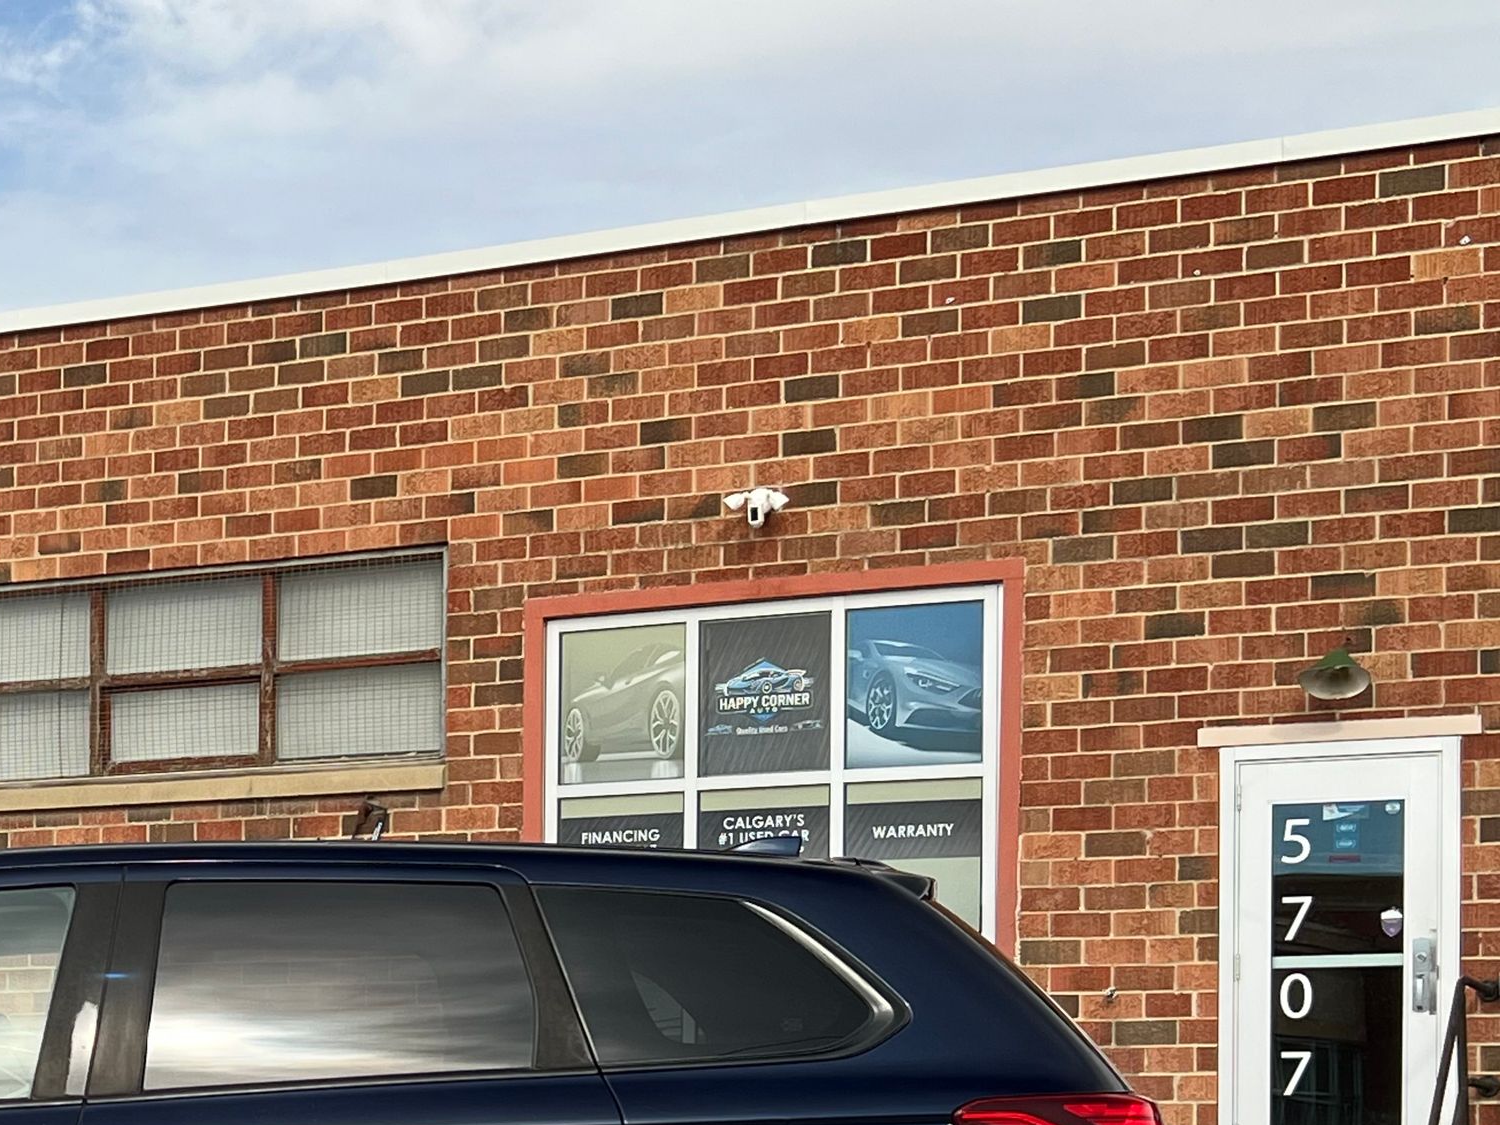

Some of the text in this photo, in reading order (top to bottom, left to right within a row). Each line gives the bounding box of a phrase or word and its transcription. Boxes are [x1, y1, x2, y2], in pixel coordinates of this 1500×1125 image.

[719, 692, 810, 711] HAPPY CORNER
[749, 706, 778, 714] AUTO
[723, 813, 805, 830] CALGARY'S
[581, 829, 660, 845] FINANCING
[718, 832, 734, 845] #1
[872, 823, 954, 839] WARRANTY
